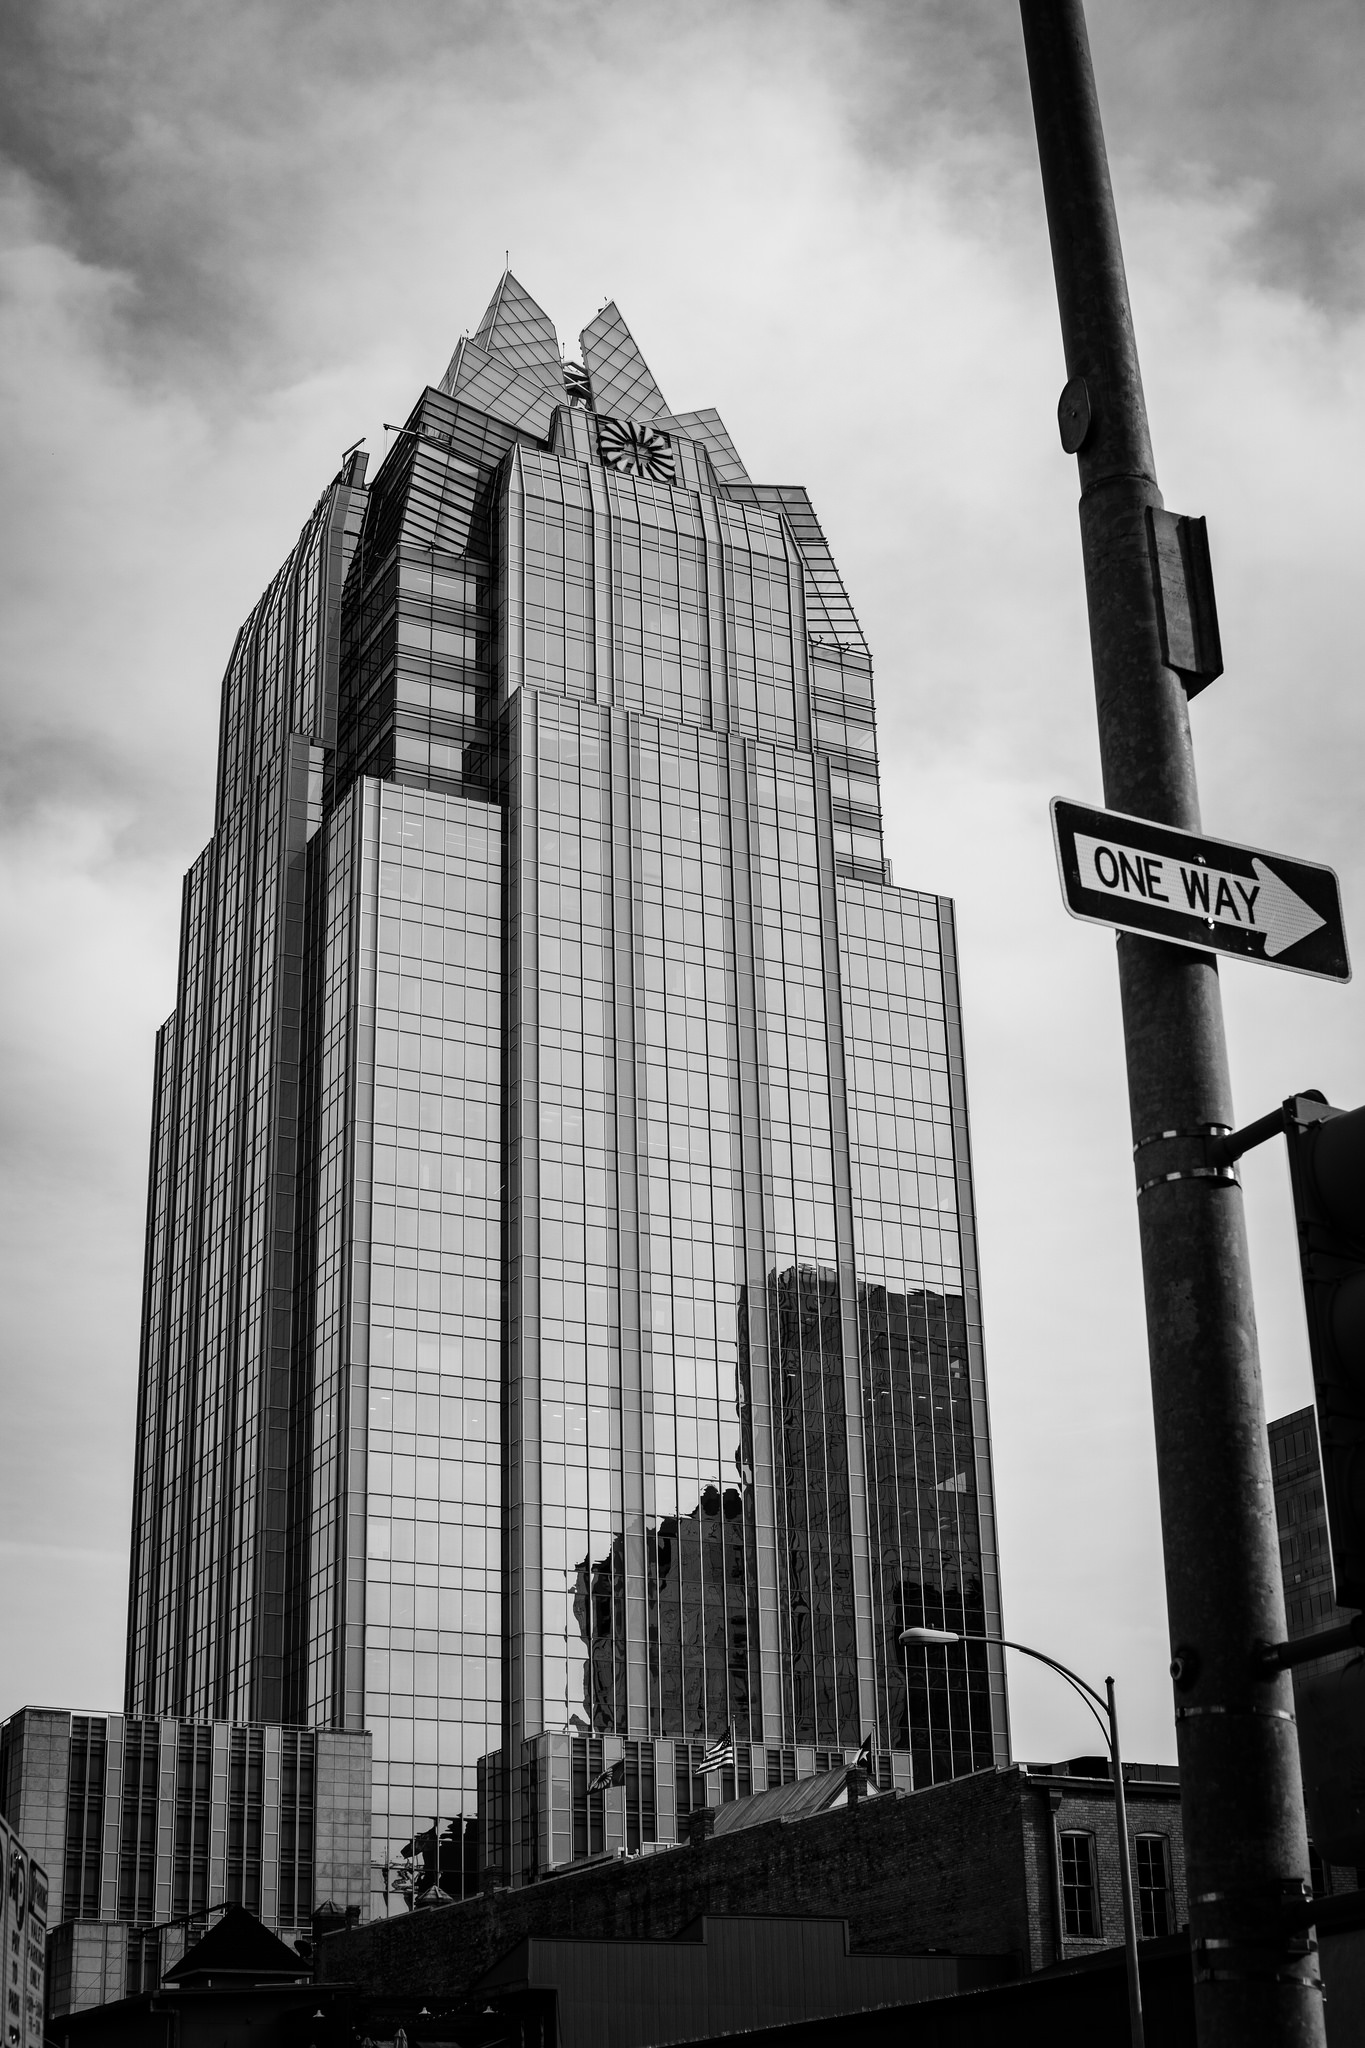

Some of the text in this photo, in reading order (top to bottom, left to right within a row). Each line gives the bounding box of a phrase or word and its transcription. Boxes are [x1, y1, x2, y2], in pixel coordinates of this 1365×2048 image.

[1094, 846, 1261, 925] ONE WAY
[12, 1929, 20, 1956] PAY
[30, 1919, 43, 1946] VALET
[30, 1966, 41, 1991] ONLY
